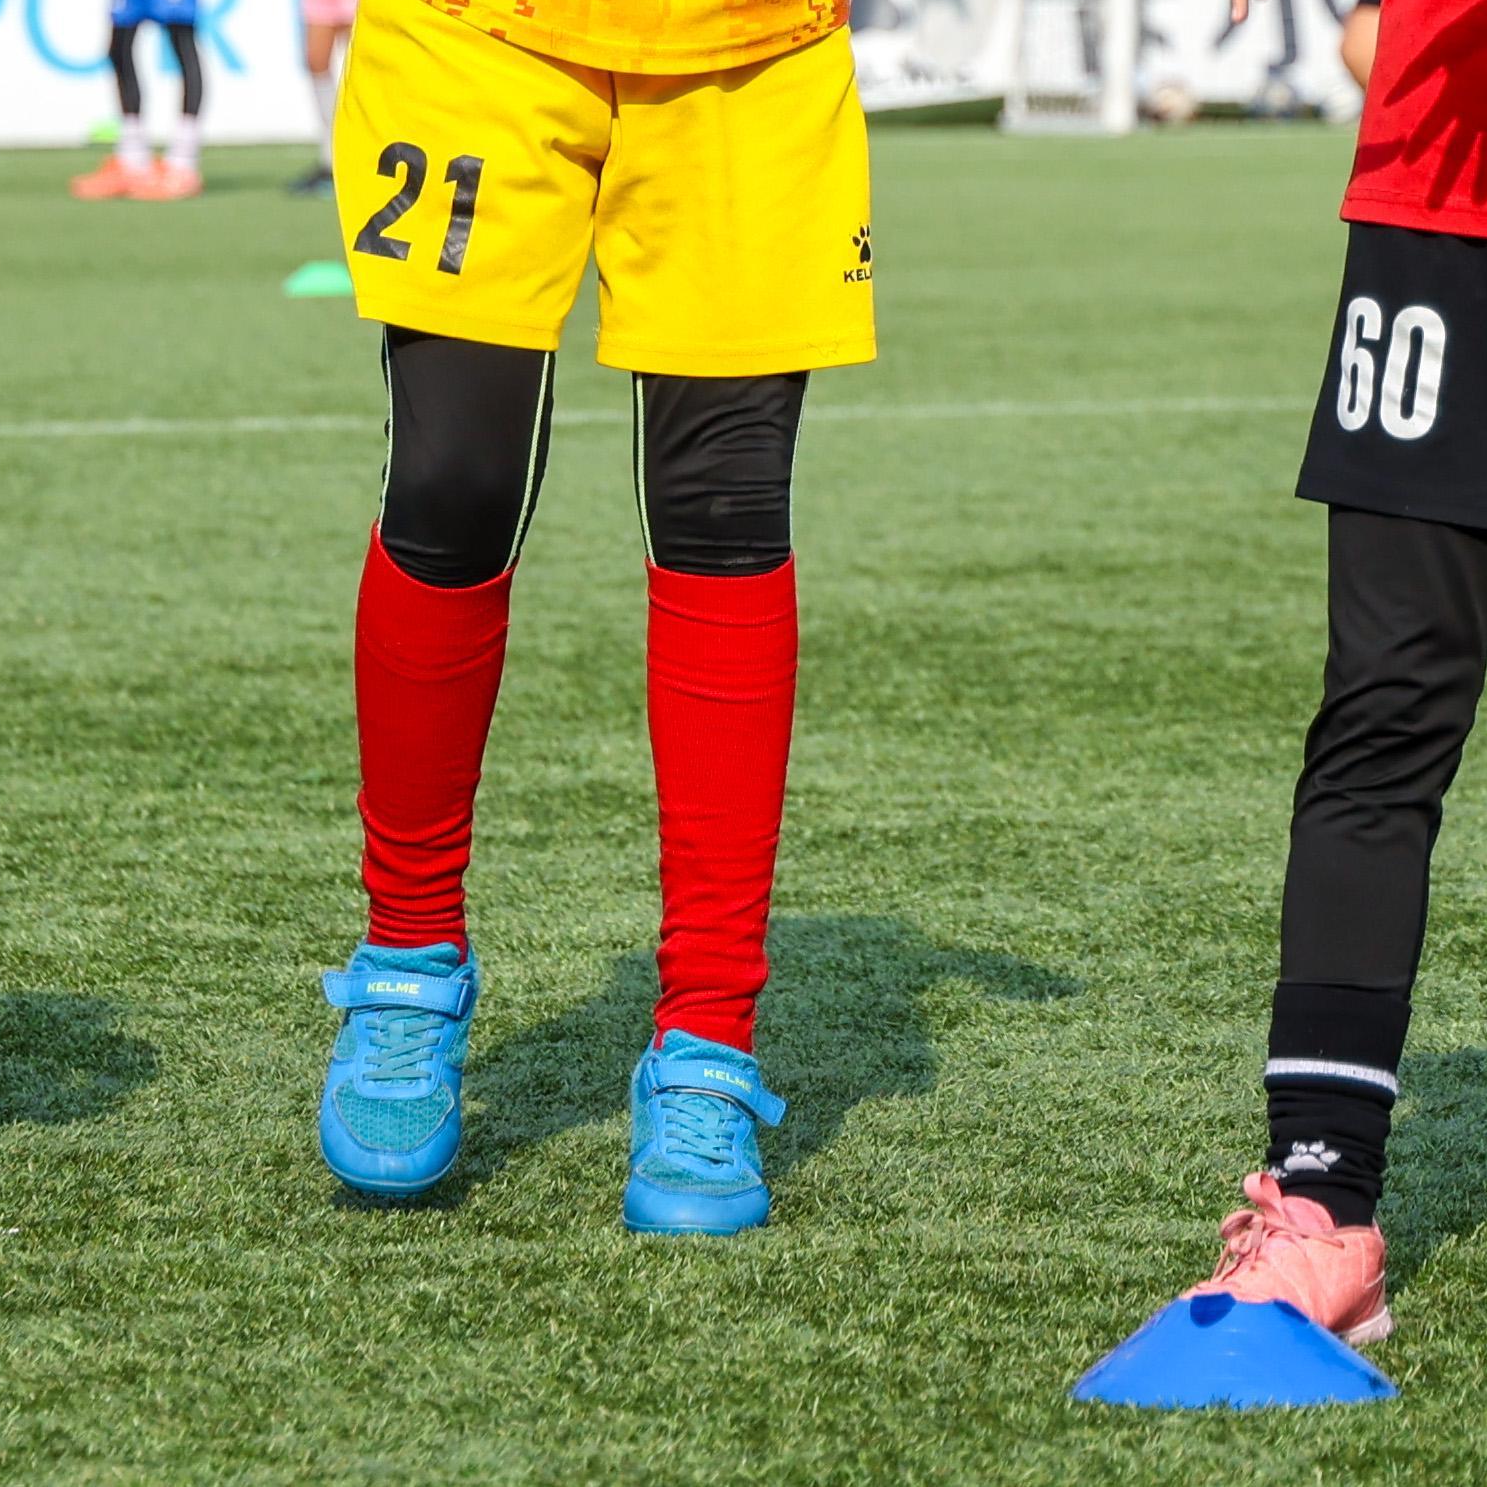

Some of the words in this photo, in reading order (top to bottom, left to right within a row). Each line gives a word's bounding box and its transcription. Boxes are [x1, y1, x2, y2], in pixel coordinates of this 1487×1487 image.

[352, 140, 485, 276] 21
[843, 268, 872, 283] KEL
[1335, 296, 1447, 441] 60
[366, 981, 421, 995] KELME
